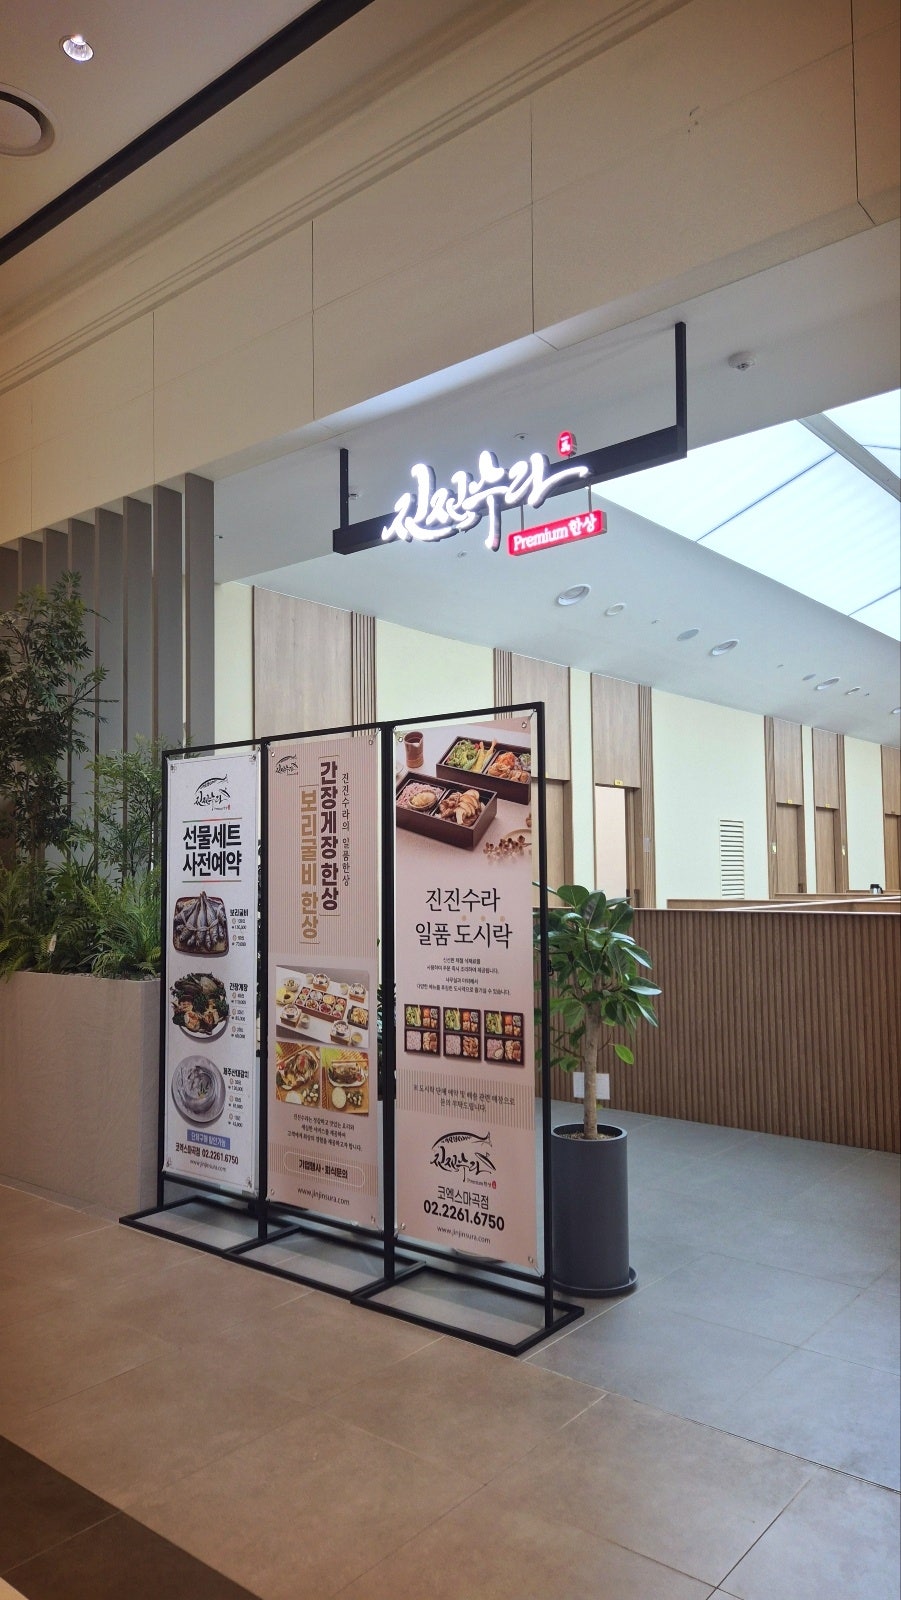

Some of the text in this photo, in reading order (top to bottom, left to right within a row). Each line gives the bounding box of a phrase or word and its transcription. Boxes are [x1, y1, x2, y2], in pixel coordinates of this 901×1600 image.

[381, 450, 589, 552] 진진수라
[512, 513, 597, 552] Premium 한상
[342, 773, 350, 832] 진진수라의
[182, 823, 242, 850] 선물세트
[182, 850, 242, 877] 사전예약
[300, 789, 319, 939] 보리굴비 한상
[229, 908, 249, 917] 보리굴비
[425, 887, 501, 913] 진진수라
[415, 922, 513, 949] 일품 도시락
[229, 982, 249, 992] 간장게장
[201, 1148, 239, 1165] 02.2261.6750
[430, 1146, 492, 1182] 진진수라
[437, 1185, 489, 1210] 코엑스마곡점
[423, 1199, 505, 1231] 02.2261.6750
